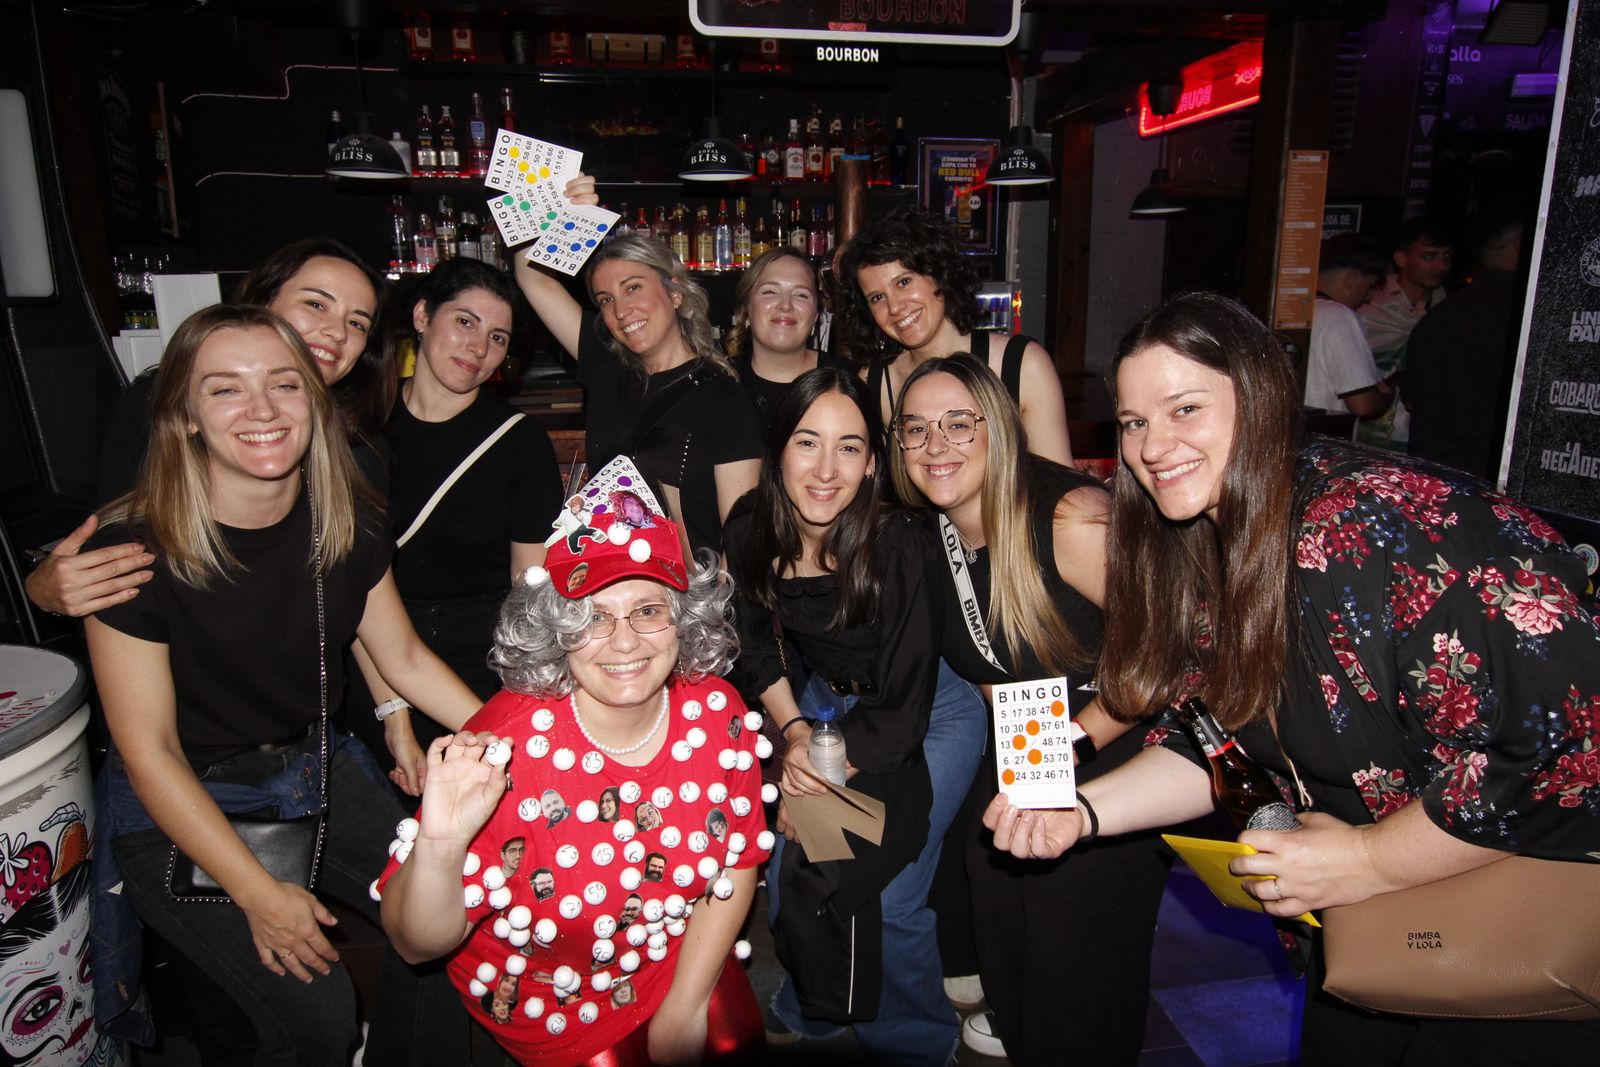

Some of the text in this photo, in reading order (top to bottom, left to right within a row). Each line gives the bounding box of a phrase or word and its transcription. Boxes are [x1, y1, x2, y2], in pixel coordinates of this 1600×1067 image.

[840, 0, 968, 24] BOURBON
[816, 46, 880, 62] BOURBON
[525, 141, 532, 150] 68
[334, 151, 373, 162] BLISS
[490, 134, 510, 184] BINGO
[523, 152, 530, 160] 58
[534, 144, 543, 163] 50 72
[690, 153, 727, 164] BLISS
[504, 137, 522, 188] 14 23 32 73
[555, 161, 562, 170] 51
[1000, 160, 1036, 170] BLISS
[518, 173, 524, 181] 25
[494, 201, 519, 242] BINGO
[532, 250, 577, 271] BINGO
[1571, 311, 1600, 325] LIN
[583, 460, 623, 493] INGO
[608, 483, 619, 492] 35
[943, 523, 963, 576] LOLA
[964, 598, 989, 656] BIMBA
[998, 685, 1062, 703] BINGO
[1013, 709, 1022, 717] 17
[1026, 708, 1037, 716] 38
[1040, 706, 1050, 715] 47
[1000, 721, 1065, 734] 10 30 57 61
[1001, 736, 1067, 749] 13 48 74
[1004, 753, 1068, 765] 6 27 53 70
[1016, 770, 1069, 780] 24 32 46 71
[1408, 932, 1441, 940] BIMBA
